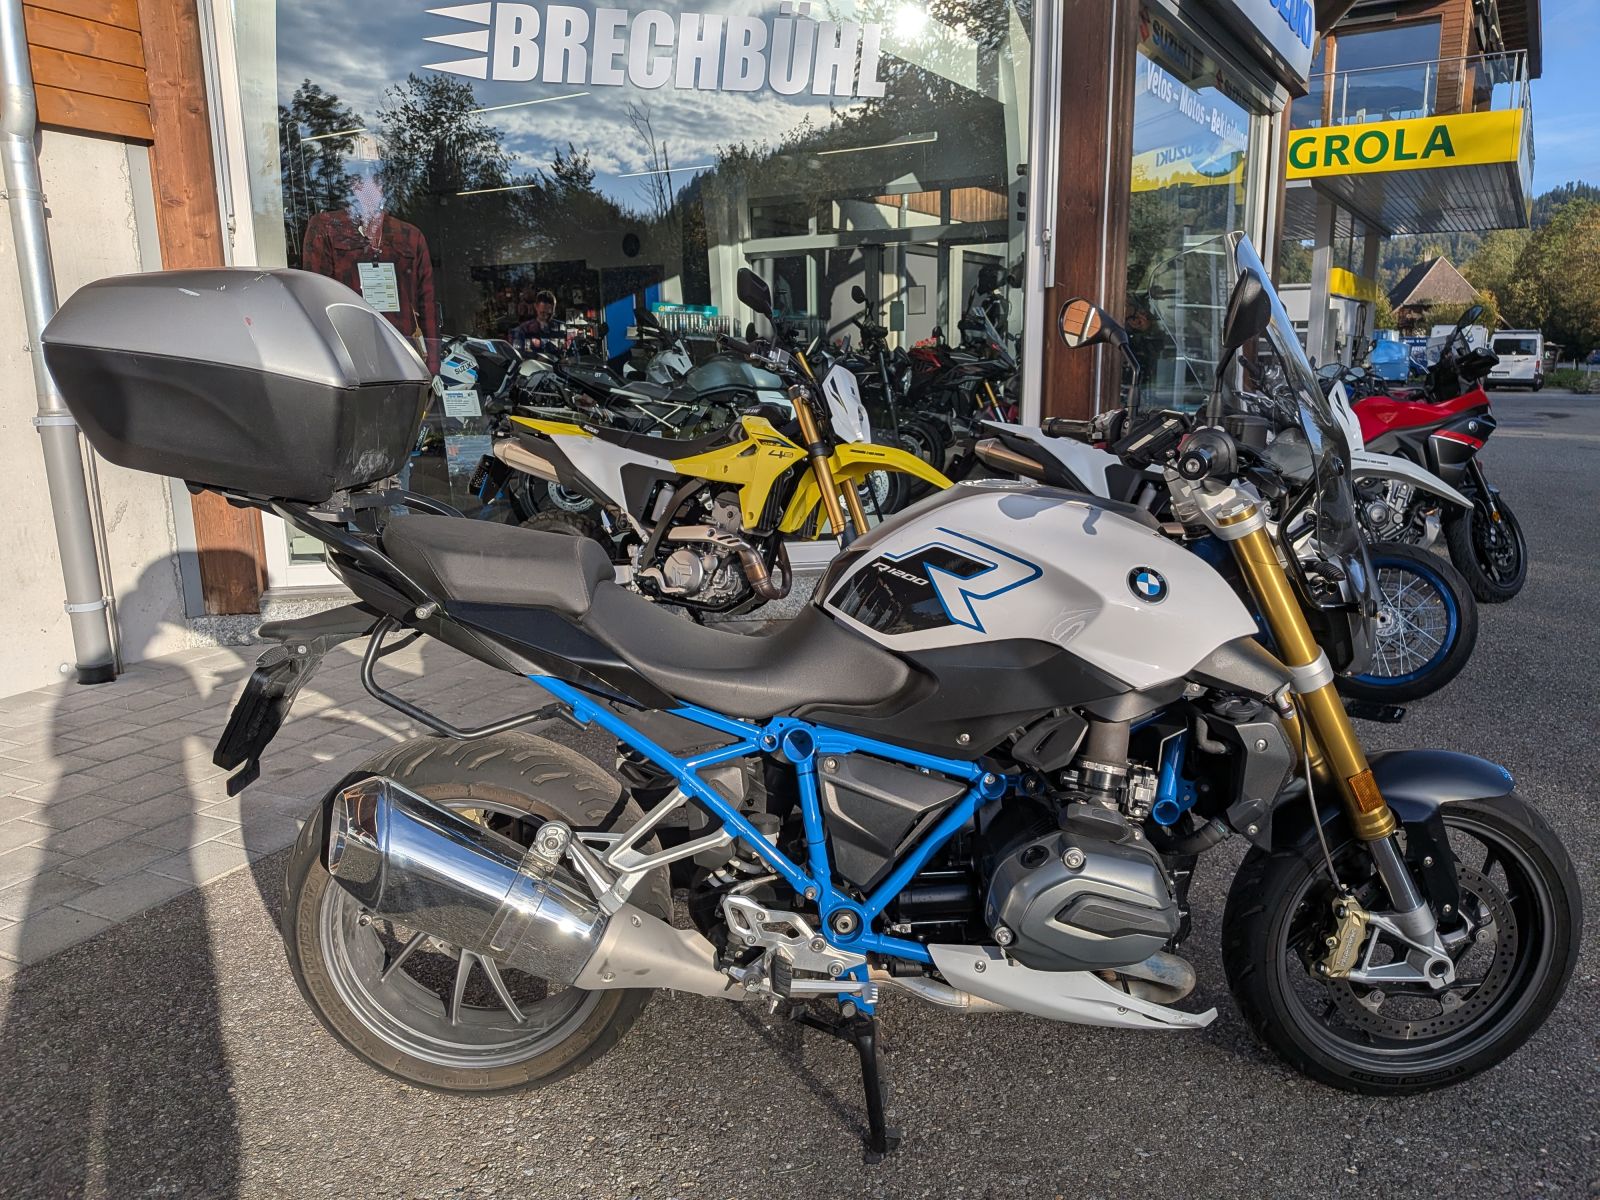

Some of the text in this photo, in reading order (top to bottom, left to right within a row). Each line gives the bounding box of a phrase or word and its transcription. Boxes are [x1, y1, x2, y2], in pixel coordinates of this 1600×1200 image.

[492, 1, 886, 97] BRECHBÜHL
[1147, 60, 1172, 104] Velos
[1179, 87, 1205, 125] Motos
[1289, 124, 1456, 170] GROLA
[454, 361, 475, 375] SUZUKI
